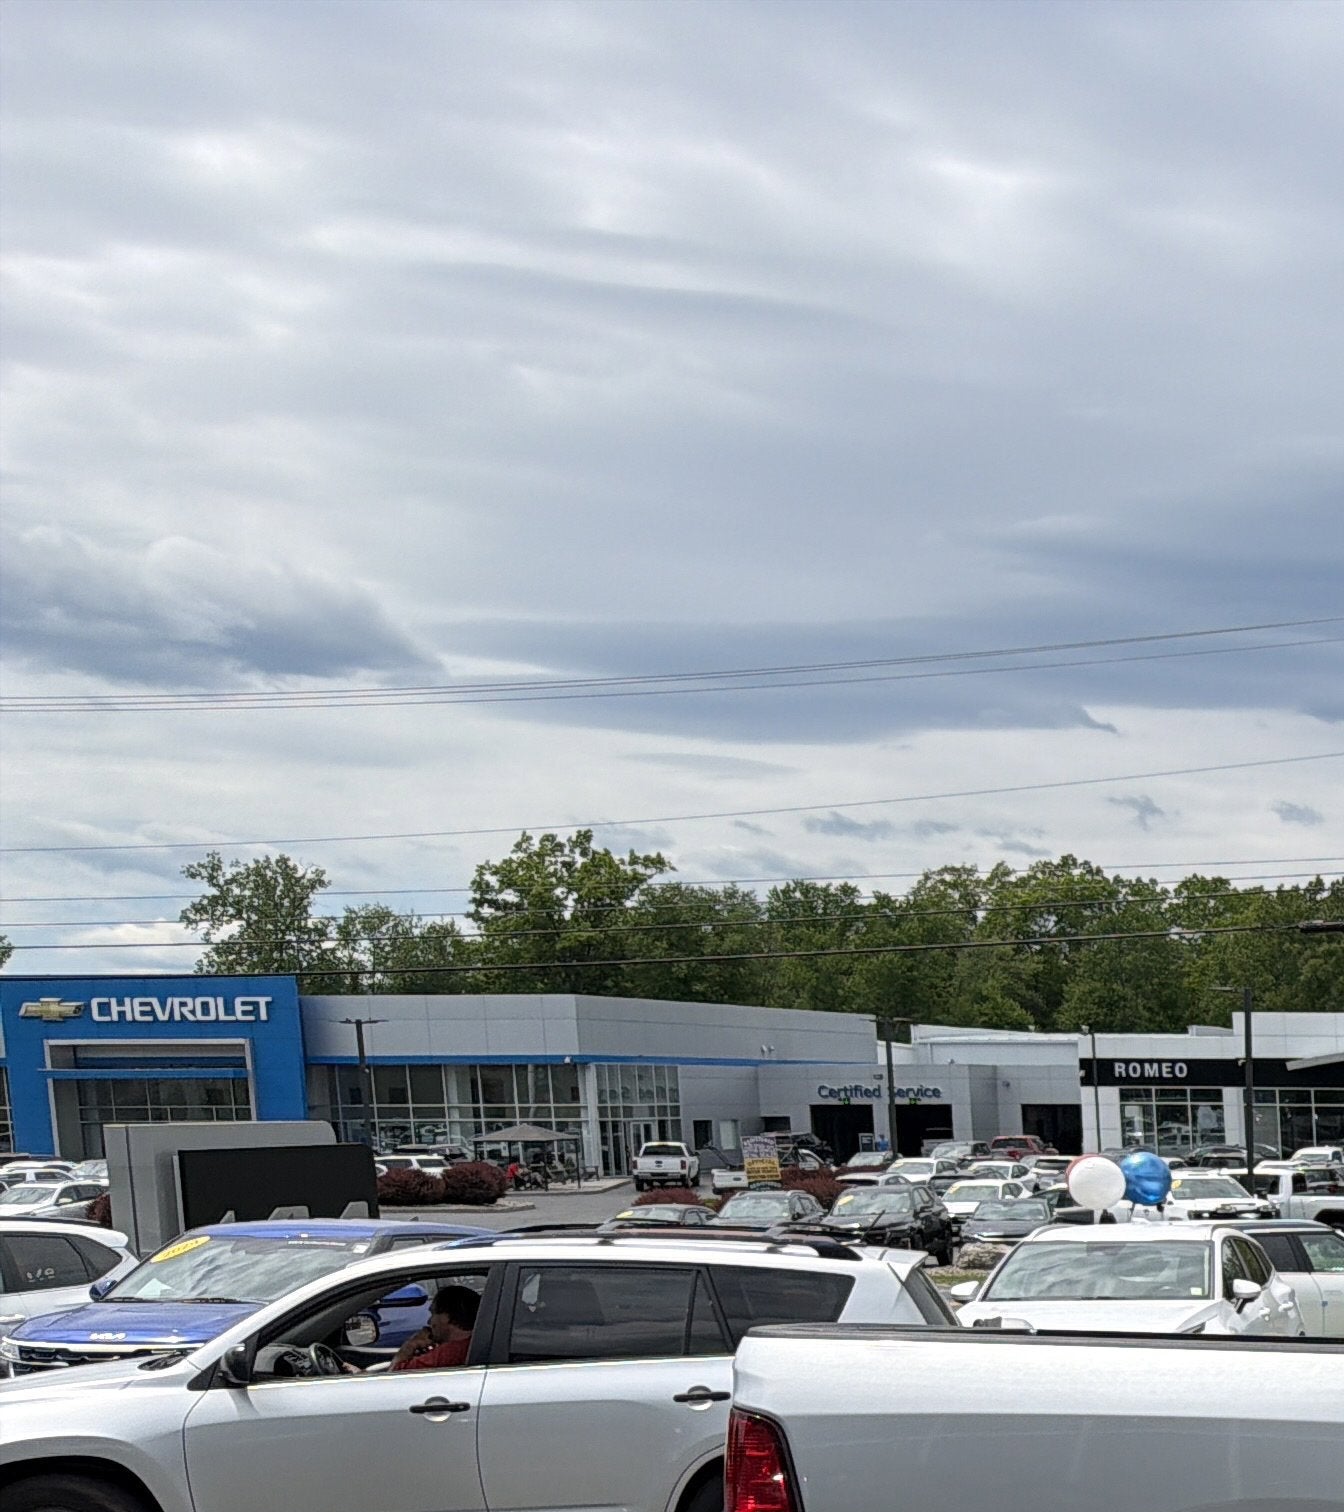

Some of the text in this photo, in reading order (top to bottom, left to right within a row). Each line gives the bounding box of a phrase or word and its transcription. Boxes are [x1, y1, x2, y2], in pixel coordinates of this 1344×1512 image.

[91, 997, 272, 1022] CHEVROLET
[1114, 1062, 1188, 1078] ROMEO
[818, 1085, 882, 1098] Certified
[896, 1085, 942, 1098] ervice
